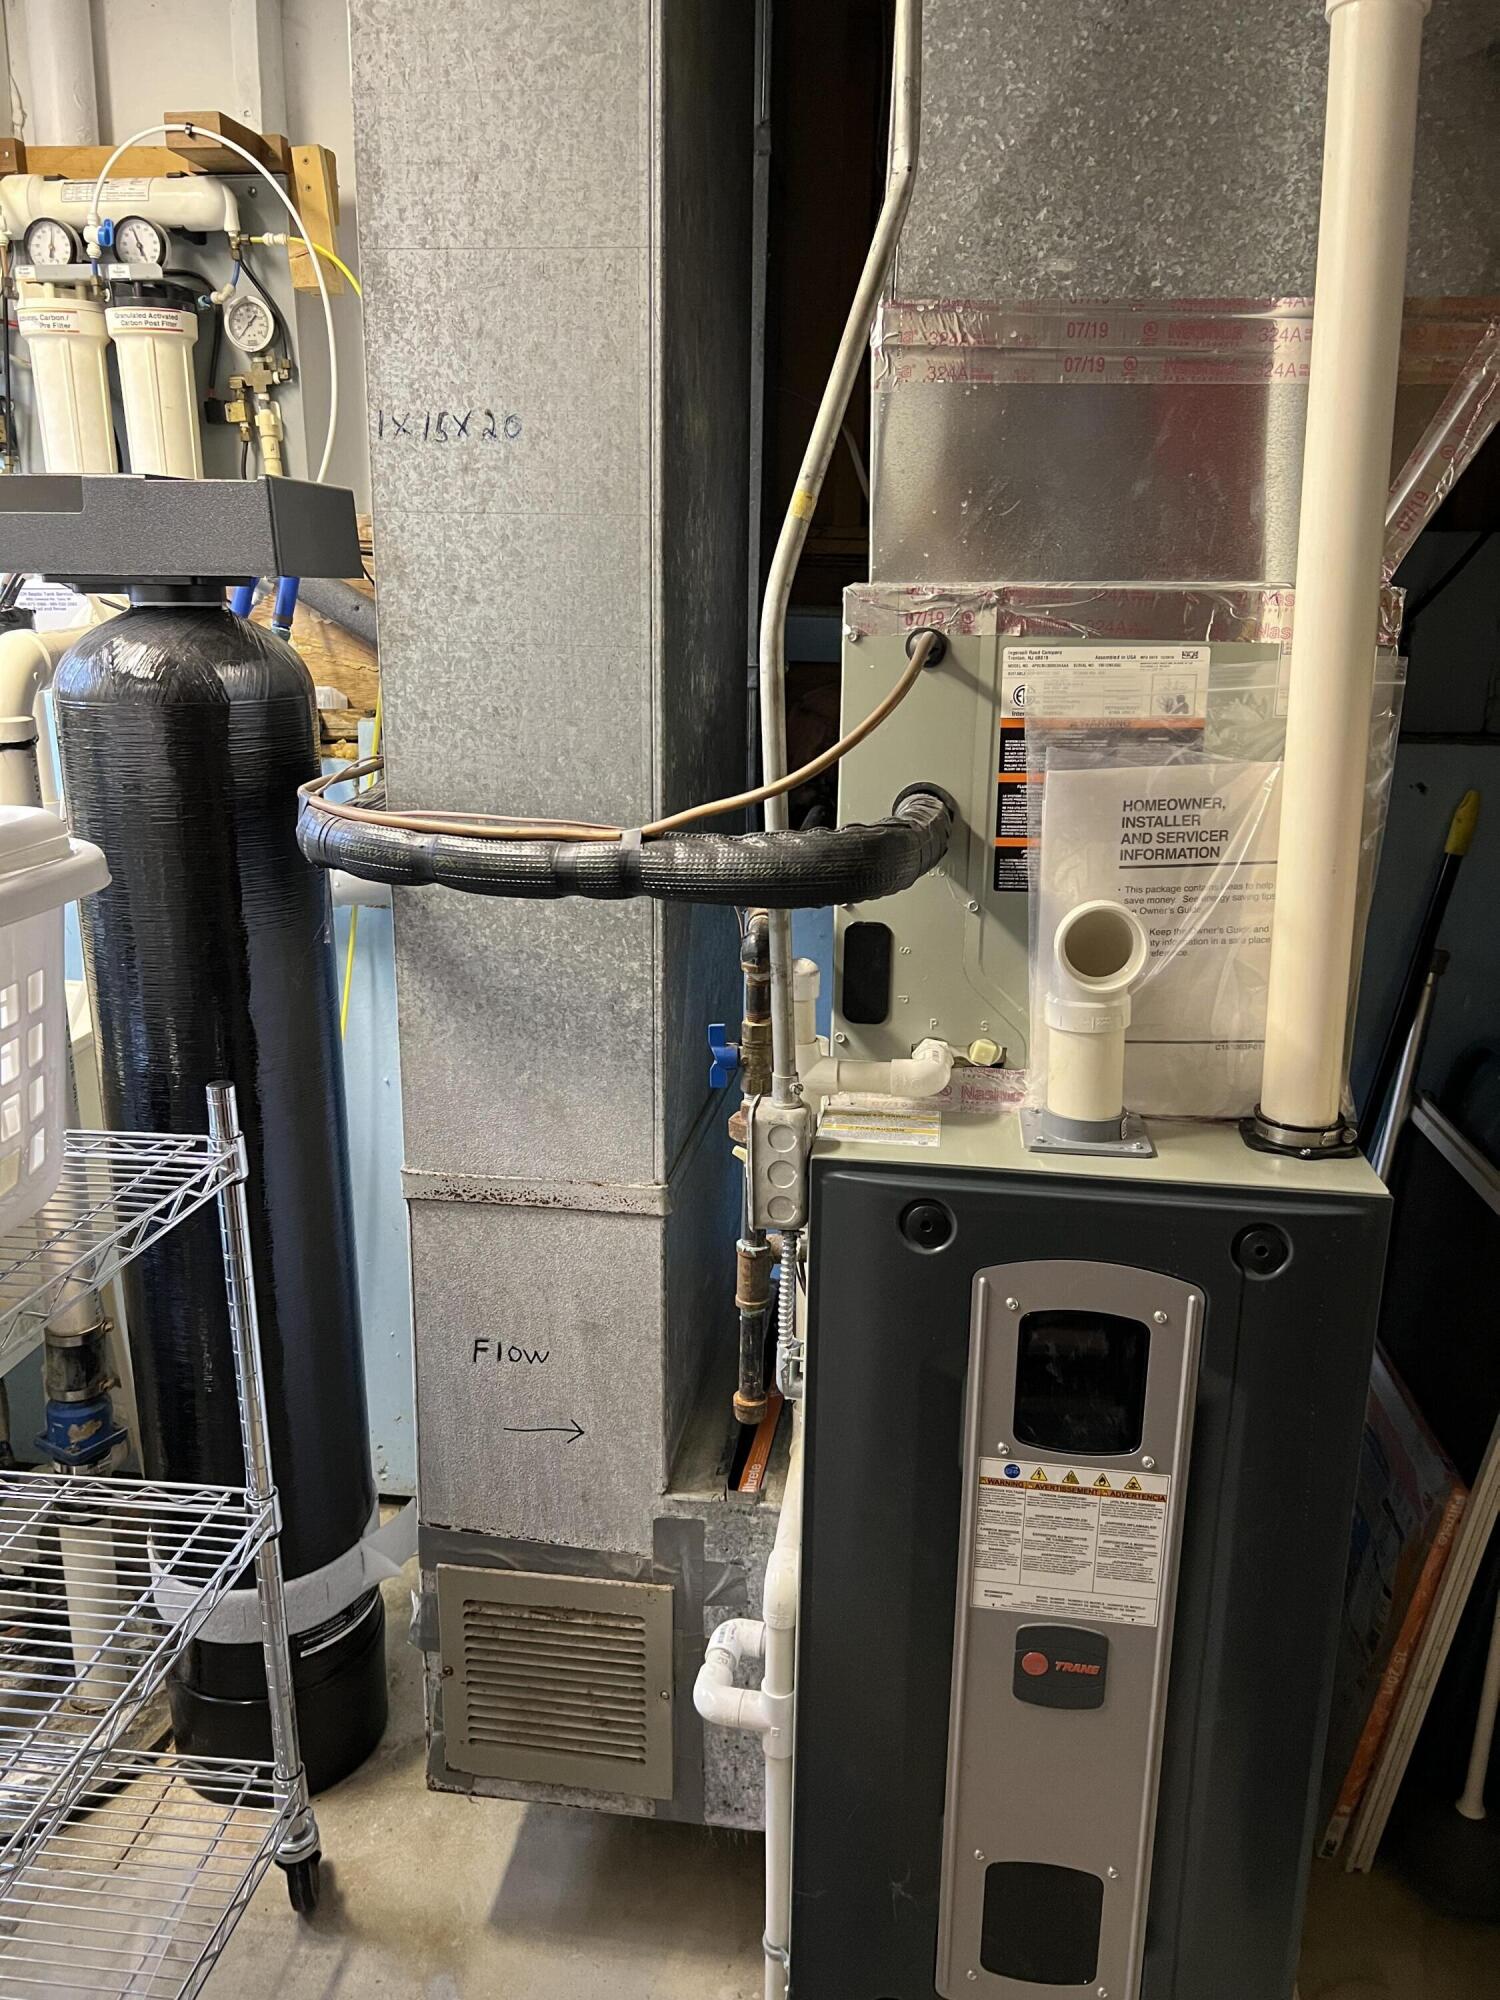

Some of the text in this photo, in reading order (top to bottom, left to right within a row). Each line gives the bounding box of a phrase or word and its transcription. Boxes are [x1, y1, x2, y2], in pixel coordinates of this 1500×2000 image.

[148, 313, 179, 321] Activated
[1067, 321, 1109, 339] 07/19
[1259, 326, 1301, 344] 324A
[1063, 356, 1105, 374] 07/19
[1254, 361, 1297, 379] 324A
[905, 611, 944, 626] 07/19
[1122, 797, 1226, 812] HOMEOWNER,
[1121, 814, 1201, 829] INSTALLER
[1120, 829, 1229, 845] AND SERVICER
[1119, 846, 1221, 861] INFORMATION
[1125, 885, 1143, 894] This
[1145, 885, 1181, 895] package
[1140, 907, 1175, 915] Owner's
[1150, 928, 1172, 937] Keep
[1253, 924, 1269, 933] and
[928, 1018, 990, 1033] P S
[473, 1338, 550, 1364] Flow
[987, 1478, 1167, 1502] WARNING AVERTISSEMENT ADVERTENCIA
[1055, 1661, 1101, 1676] TRANE
